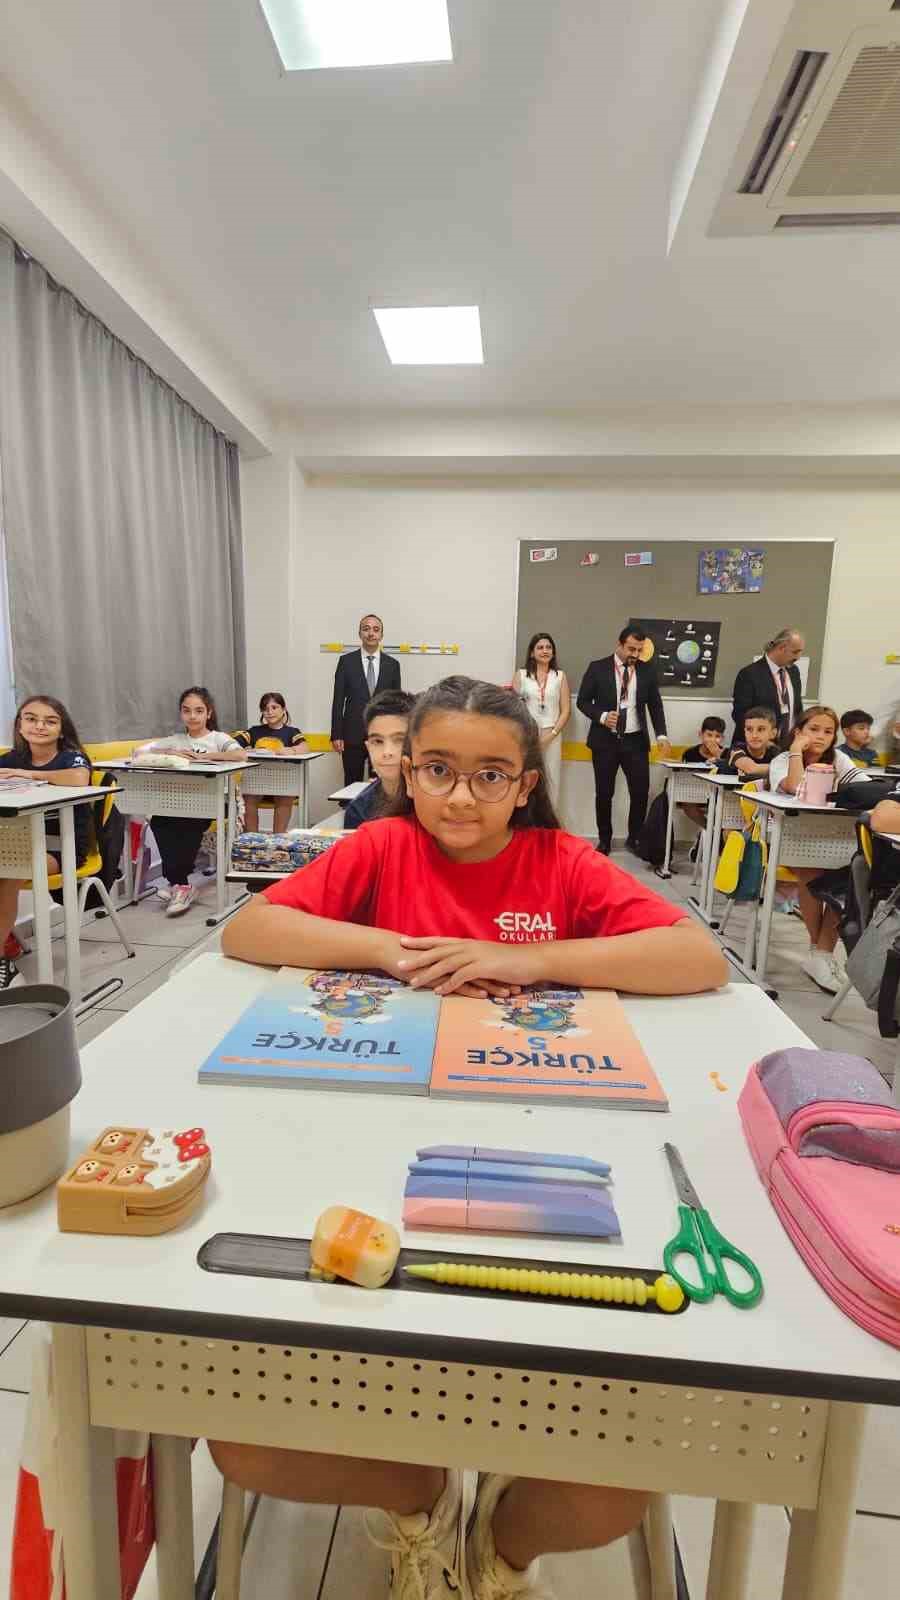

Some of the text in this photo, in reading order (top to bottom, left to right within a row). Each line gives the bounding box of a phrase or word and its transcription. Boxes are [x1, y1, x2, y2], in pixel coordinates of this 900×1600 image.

[493, 911, 557, 932] ERAL
[251, 1032, 401, 1058] TÜRKÇE
[527, 1037, 548, 1051] 5
[467, 1047, 621, 1074] TÜRKÇE
